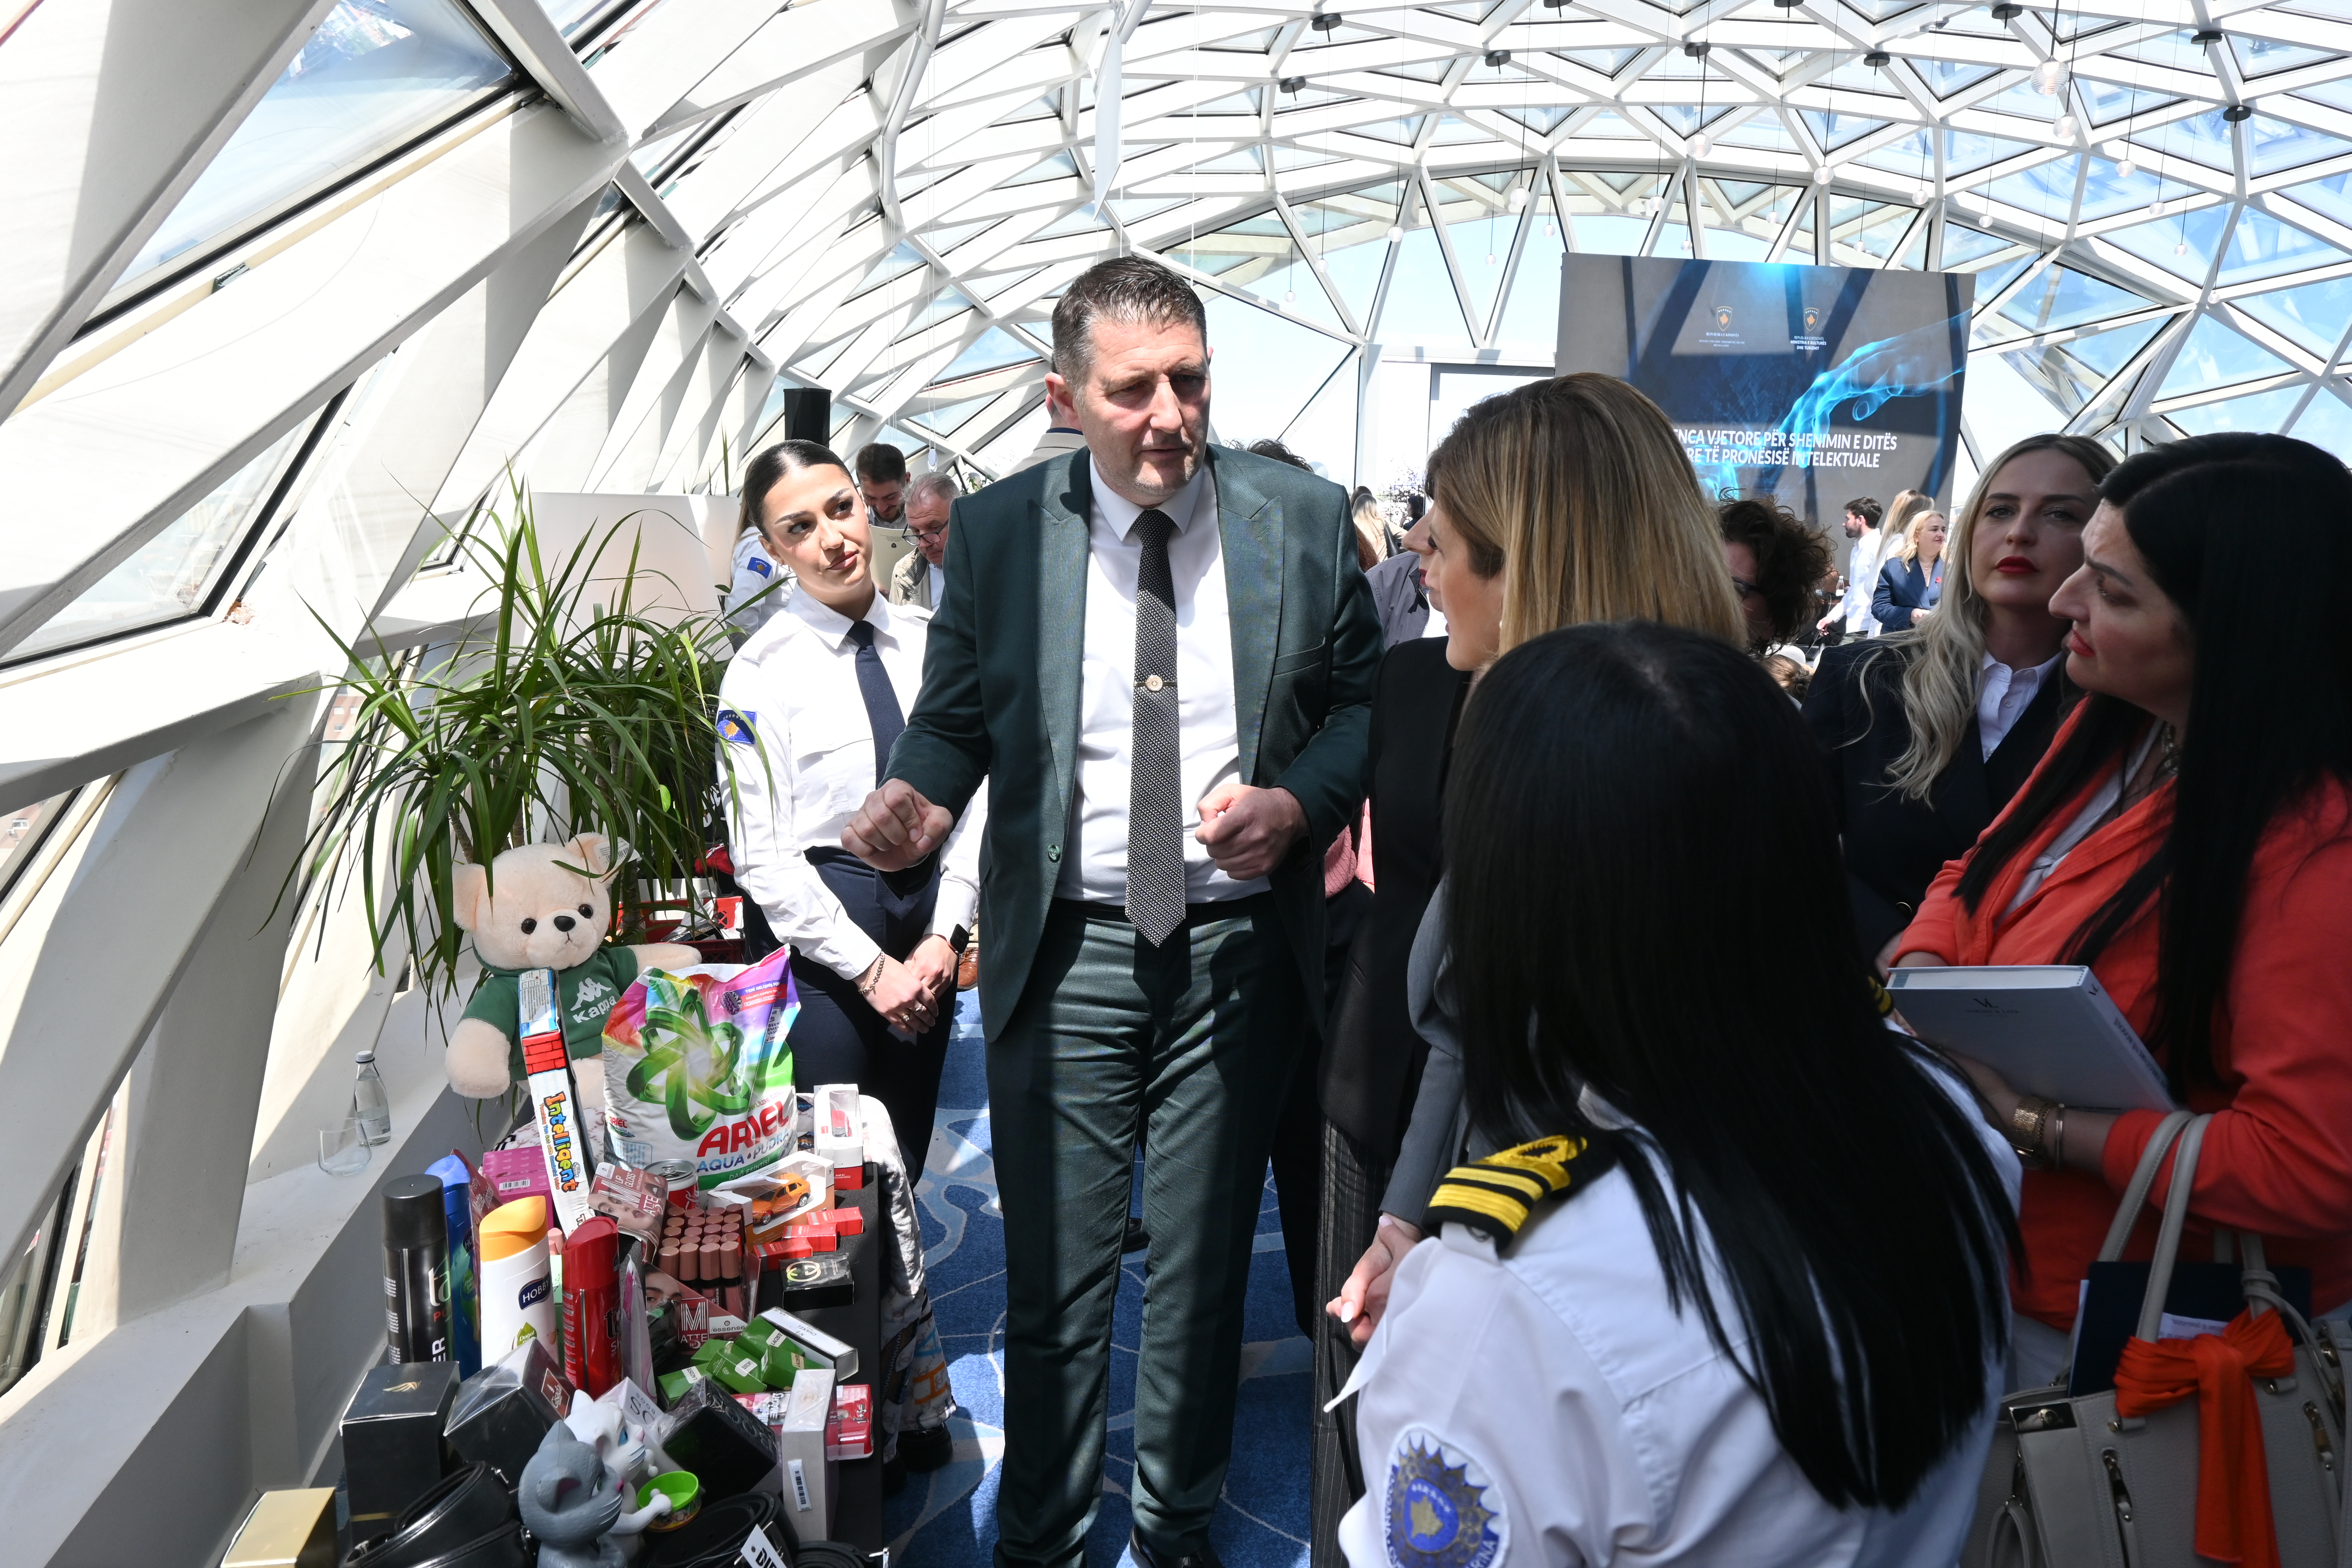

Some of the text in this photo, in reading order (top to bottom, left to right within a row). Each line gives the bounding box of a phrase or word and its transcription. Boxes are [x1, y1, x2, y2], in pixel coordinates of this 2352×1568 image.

[1707, 430, 1761, 446] VJETORE
[1764, 429, 1786, 446] PËR
[1788, 432, 1851, 449] SHENIMIN
[1853, 435, 1861, 449] E
[1863, 432, 1897, 450] DITËS
[1687, 445, 1881, 468] RE TË PRONËSISË INTELEKTUALE
[572, 995, 617, 1024] Kappa
[744, 999, 763, 1007] EKSTRA
[770, 1090, 784, 1100] ÖZEL
[697, 1100, 789, 1157] ARIEL
[544, 1091, 579, 1193] Intelligent
[697, 1154, 745, 1173] AQUA
[753, 1128, 789, 1159] PUDRA
[729, 1170, 744, 1180] DAĞ
[746, 1157, 770, 1176] ESİNTİSİ
[468, 1176, 481, 1192] Pretty
[615, 1175, 624, 1184] LIP
[625, 1172, 636, 1187] GLOSS
[473, 1193, 485, 1214] Matte
[523, 1278, 549, 1304] HOBBY
[770, 1332, 783, 1345] LACOSTE
[797, 1325, 817, 1336] CHANEL
[687, 1367, 697, 1380] LACOSTE
